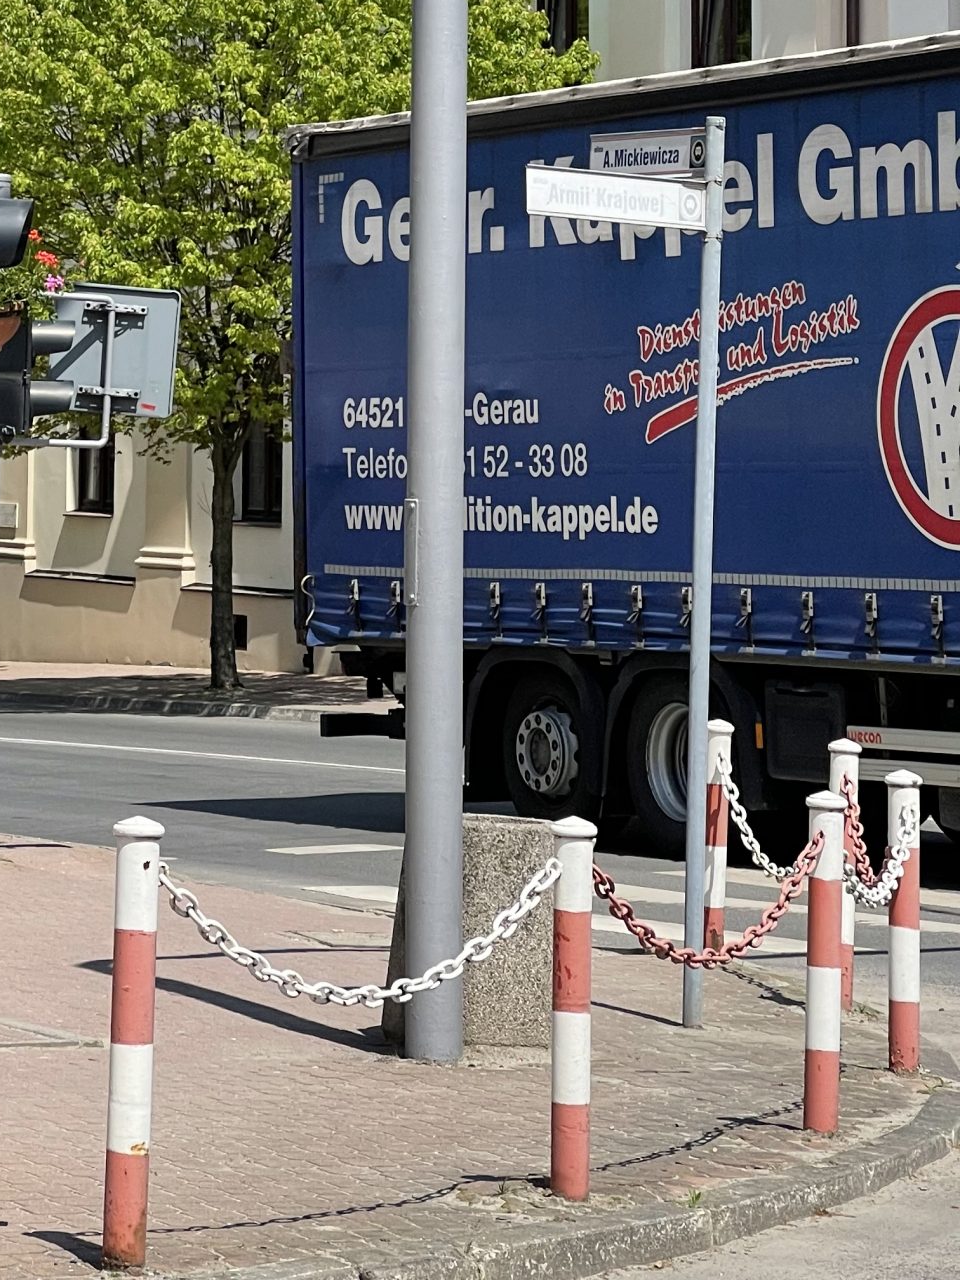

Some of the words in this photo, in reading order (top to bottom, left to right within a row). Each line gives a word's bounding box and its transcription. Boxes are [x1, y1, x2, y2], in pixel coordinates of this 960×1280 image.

[603, 146, 680, 169] A.Mickiewicza
[548, 183, 590, 205] Armii
[596, 188, 664, 216] Krajowej
[341, 178, 505, 266] Ger.
[638, 280, 806, 363] Dienstistungen
[603, 383, 627, 415] in
[628, 353, 721, 408] Transpo
[727, 325, 768, 372] und
[772, 294, 861, 357] Logistik
[343, 396, 404, 429] 64521
[464, 392, 539, 426] -Gerau
[342, 447, 408, 479] Telefo
[483, 444, 510, 478] 52
[528, 443, 555, 478] 33
[560, 442, 588, 477] 08
